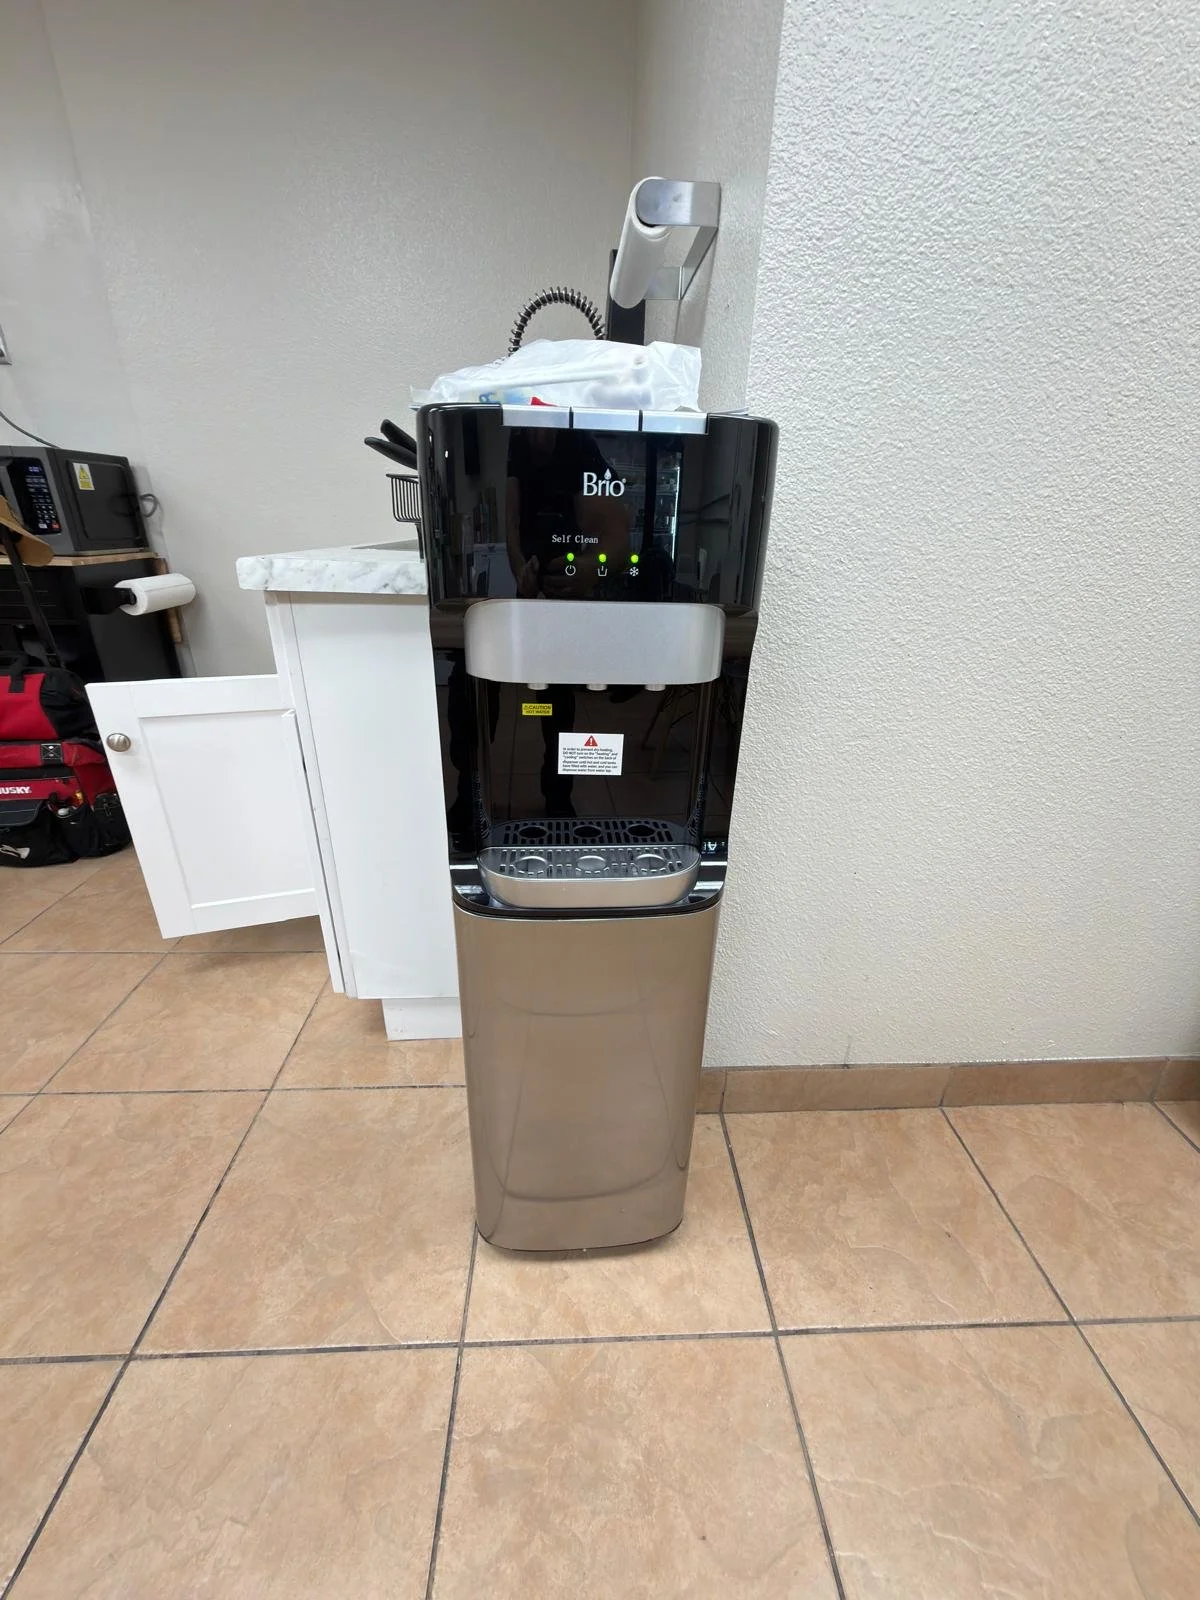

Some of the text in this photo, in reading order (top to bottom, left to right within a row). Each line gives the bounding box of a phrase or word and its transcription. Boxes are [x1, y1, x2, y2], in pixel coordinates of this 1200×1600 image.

[583, 468, 625, 497] Brio
[551, 534, 599, 544] Self Clean
[0, 786, 30, 795] USKY
